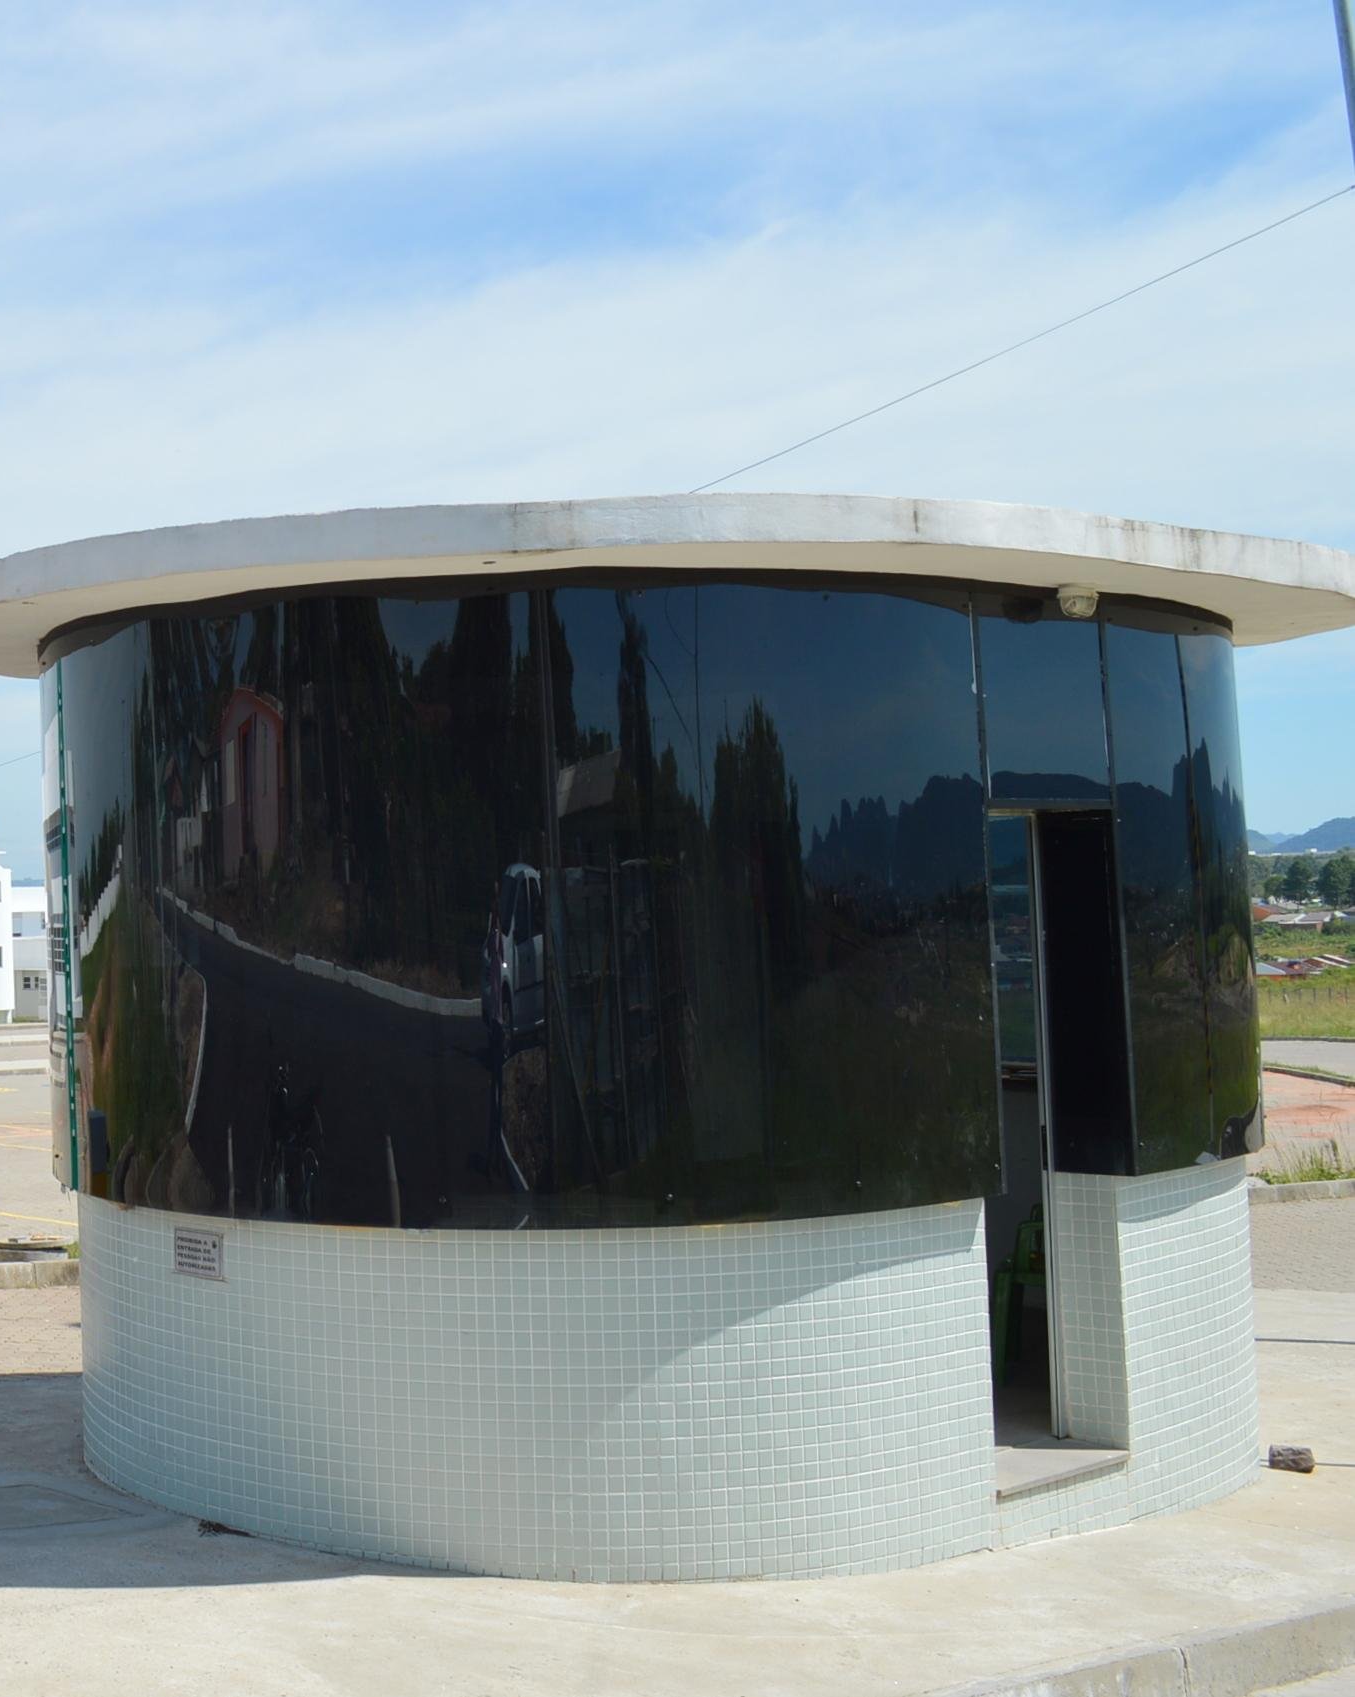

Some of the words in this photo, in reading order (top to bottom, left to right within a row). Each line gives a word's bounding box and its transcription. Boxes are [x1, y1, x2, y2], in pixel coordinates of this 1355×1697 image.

[177, 1245, 202, 1253] ENTRADA
[177, 1253, 201, 1261] PESSOAS
[202, 1255, 216, 1263] NÃO
[177, 1261, 216, 1272] AUTORIZADAS
